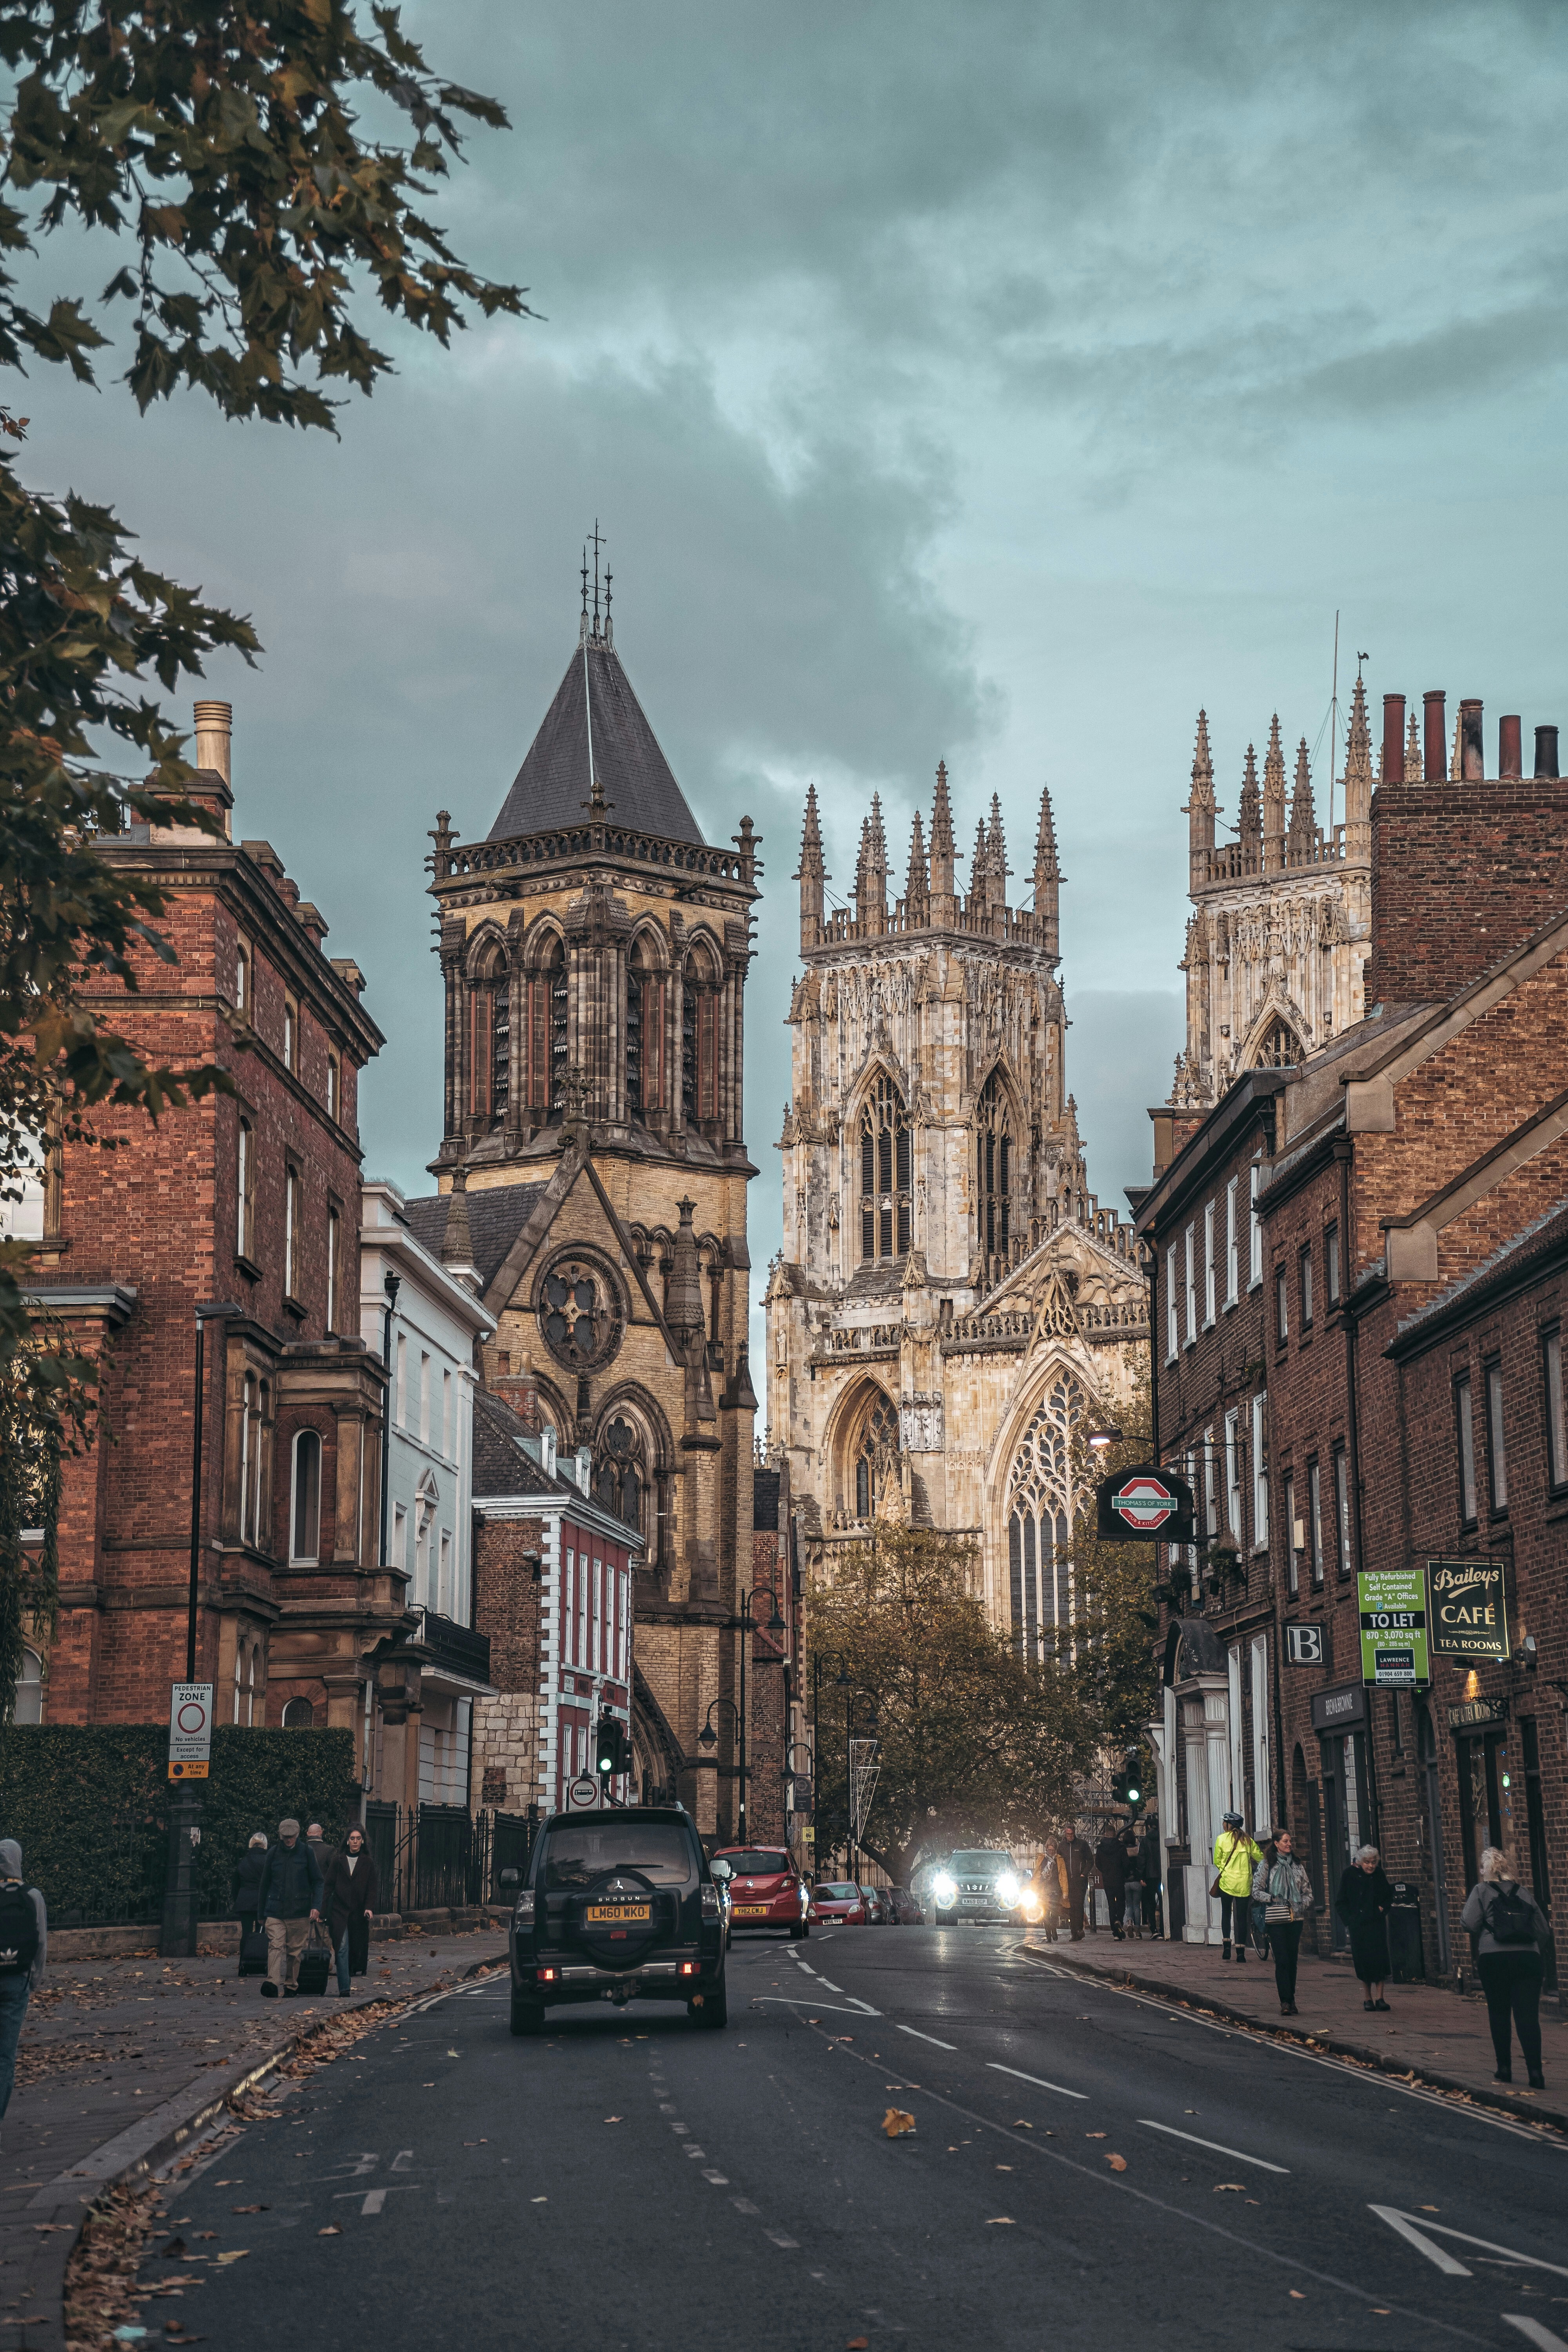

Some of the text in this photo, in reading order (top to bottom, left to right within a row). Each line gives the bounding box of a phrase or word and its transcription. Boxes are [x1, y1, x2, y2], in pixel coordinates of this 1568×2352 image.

[1128, 1514, 1137, 1523] PUB
[1142, 1515, 1162, 1526] KITCHEN
[1365, 1572, 1416, 1583] Fully Refurbished
[1434, 1567, 1499, 1591] Baileys
[1382, 1582, 1412, 1590] Contained
[1397, 1592, 1418, 1600] Offices
[1441, 1603, 1495, 1625] CAFÉ
[1370, 1613, 1415, 1628] TO LET
[1366, 1631, 1379, 1640] 870
[1384, 1631, 1404, 1641] 3,070
[1405, 1632, 1414, 1641] sq
[1415, 1630, 1421, 1638] ft
[1290, 1628, 1319, 1660] B
[1439, 1639, 1502, 1650] TEA ROOMS
[179, 1693, 205, 1701] ZONE
[1449, 1709, 1460, 1724] CAFE
[1461, 1708, 1465, 1722] &
[1465, 1706, 1474, 1721] TEA
[592, 1906, 645, 1918] LM60 WKO
